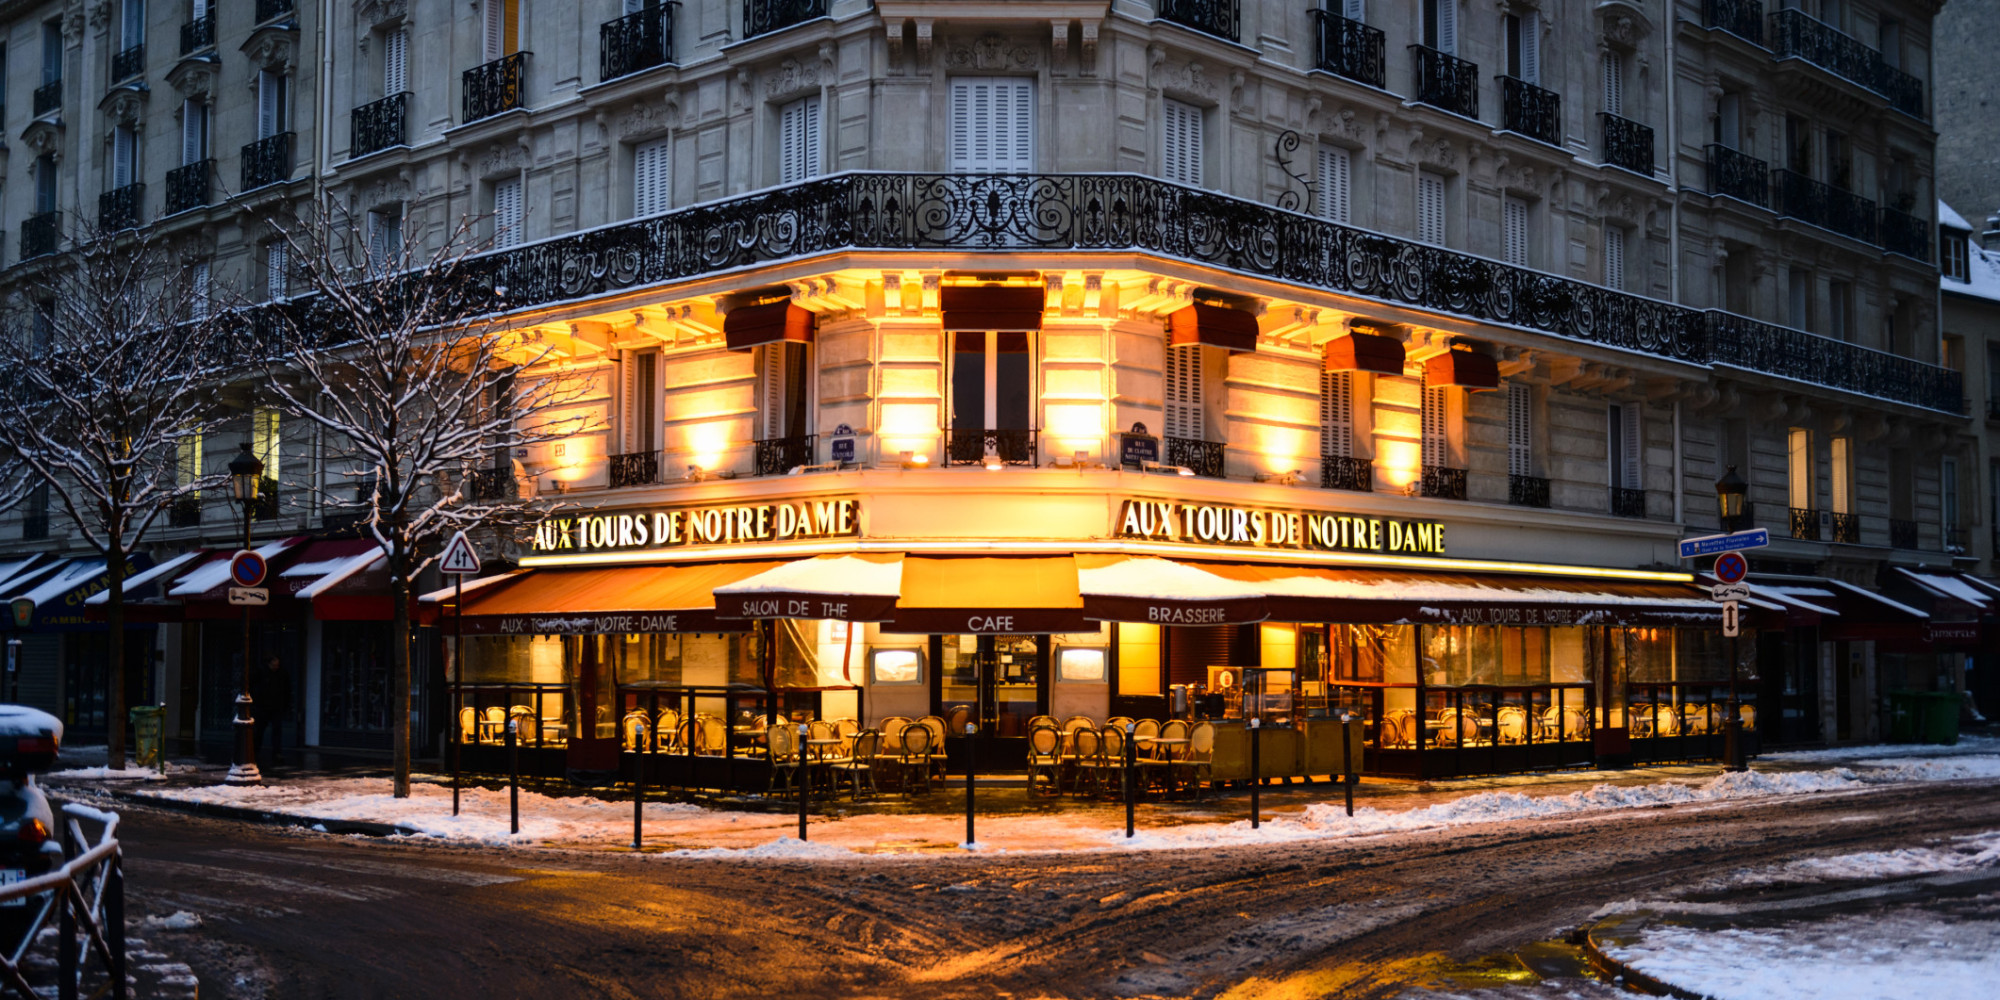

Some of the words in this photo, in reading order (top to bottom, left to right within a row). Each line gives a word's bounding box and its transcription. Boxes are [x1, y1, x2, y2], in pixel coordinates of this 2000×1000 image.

[532, 518, 573, 550] AUX
[576, 513, 648, 548] TOURS
[654, 511, 683, 544] DE
[689, 505, 771, 542] NOTRE
[777, 500, 855, 538] DAME
[1121, 500, 1173, 537] AUX
[1180, 504, 1263, 542] TOURS
[1271, 512, 1299, 544] DE
[1307, 514, 1382, 550] NOTRE
[1388, 520, 1445, 553] DAME
[65, 561, 137, 606] CHANE
[742, 600, 779, 616] SALON
[788, 600, 809, 616] DE
[821, 602, 848, 618] THE
[1148, 606, 1226, 623] BRASSERIE
[1462, 608, 1483, 622] AUX
[1488, 608, 1520, 623] TOURS
[1525, 608, 1538, 623] DE
[501, 618, 524, 632] AUX
[530, 617, 565, 632] TOURS
[594, 615, 677, 632] NOTRE-DAME
[968, 616, 1013, 631] CAFE
